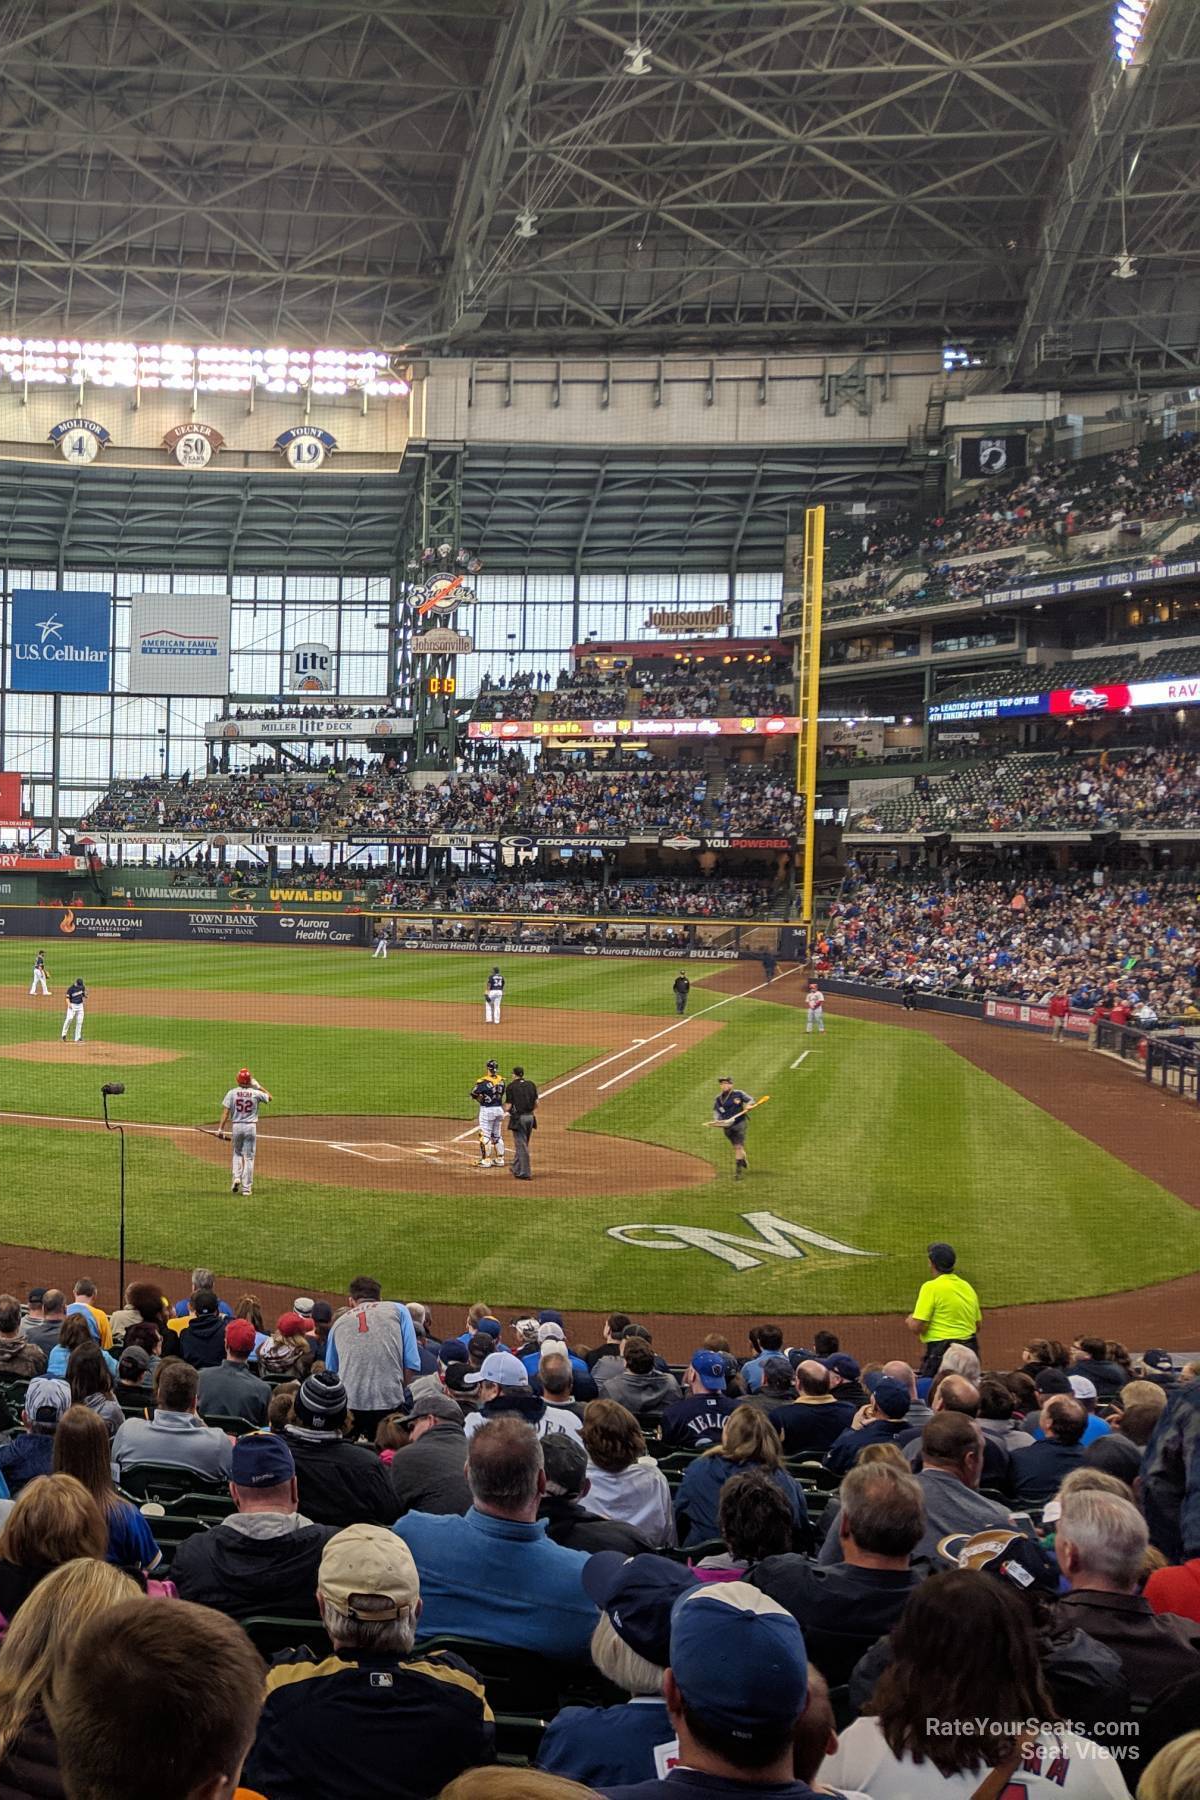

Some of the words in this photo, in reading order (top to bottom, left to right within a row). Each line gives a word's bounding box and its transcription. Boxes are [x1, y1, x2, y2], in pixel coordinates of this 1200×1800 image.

[58, 419, 102, 434] MOLITOR
[174, 426, 212, 438] UECKER
[289, 427, 324, 438] YOUNT
[72, 436, 85, 456] 4
[182, 437, 205, 456] 50
[293, 442, 320, 464] 19
[644, 604, 733, 628] Johnsonville
[141, 639, 184, 648] AMERICAN
[186, 640, 217, 649] FAMILY
[413, 637, 471, 651] Johnsonville
[15, 644, 41, 660] U.S.
[43, 644, 108, 662] Cellular
[294, 652, 328, 675] Lite
[430, 678, 456, 693] 0:13
[941, 702, 969, 713] LEADING
[971, 701, 984, 710] OFF
[985, 700, 998, 708] THE
[1000, 698, 1013, 707] TOP
[1014, 697, 1024, 705] OF
[1025, 696, 1039, 704] THE
[969, 709, 983, 718] FOR
[984, 708, 998, 717] THE
[261, 724, 297, 732] MILLER
[326, 723, 353, 731] DECK
[593, 721, 617, 734] Call
[270, 889, 343, 901] UWM.EDU
[76, 918, 142, 928] POTAWATOMI
[189, 914, 223, 924] TOWN
[226, 915, 257, 926] BANK
[297, 919, 330, 928] Aurora
[295, 930, 327, 940] Health
[330, 931, 352, 941] Care
[792, 929, 806, 937] 345
[420, 942, 448, 950] Aurora
[450, 942, 478, 951] Health
[479, 943, 498, 951] Care
[504, 944, 551, 953] BULLPEN
[600, 947, 631, 955] Aurora
[632, 948, 661, 957] Health
[663, 949, 680, 957] Care
[689, 950, 739, 959] BULLPEN
[236, 1099, 253, 1113] 52
